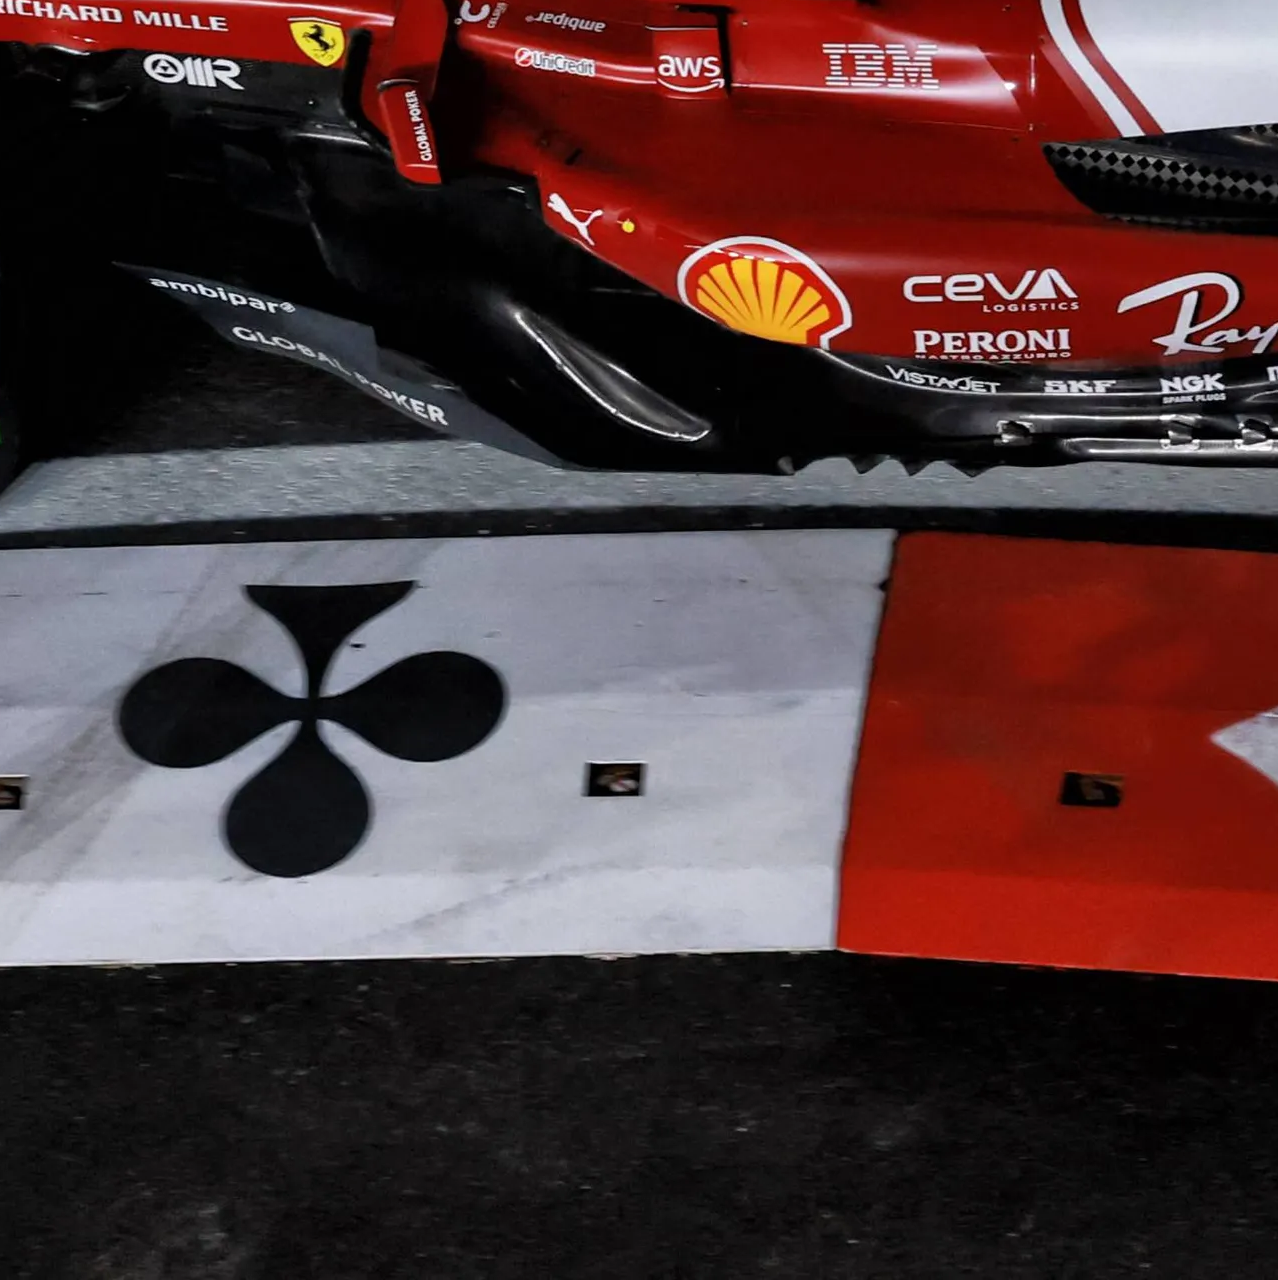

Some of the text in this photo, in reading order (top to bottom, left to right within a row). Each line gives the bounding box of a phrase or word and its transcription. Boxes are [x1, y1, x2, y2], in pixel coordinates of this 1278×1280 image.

[132, 9, 229, 32] MILLE
[531, 51, 596, 77] UniCredit
[658, 55, 720, 79] aws
[822, 44, 940, 90] IBM
[405, 90, 432, 161] GLOBAL POKER
[983, 302, 1079, 312] LOGISTICS
[913, 328, 1070, 354] PERONI
[231, 325, 449, 426] GLOBAL POKER
[1044, 380, 1116, 393] SKF
[1159, 373, 1225, 393] NGK
[1162, 393, 1227, 403] SPARK PLUGS
